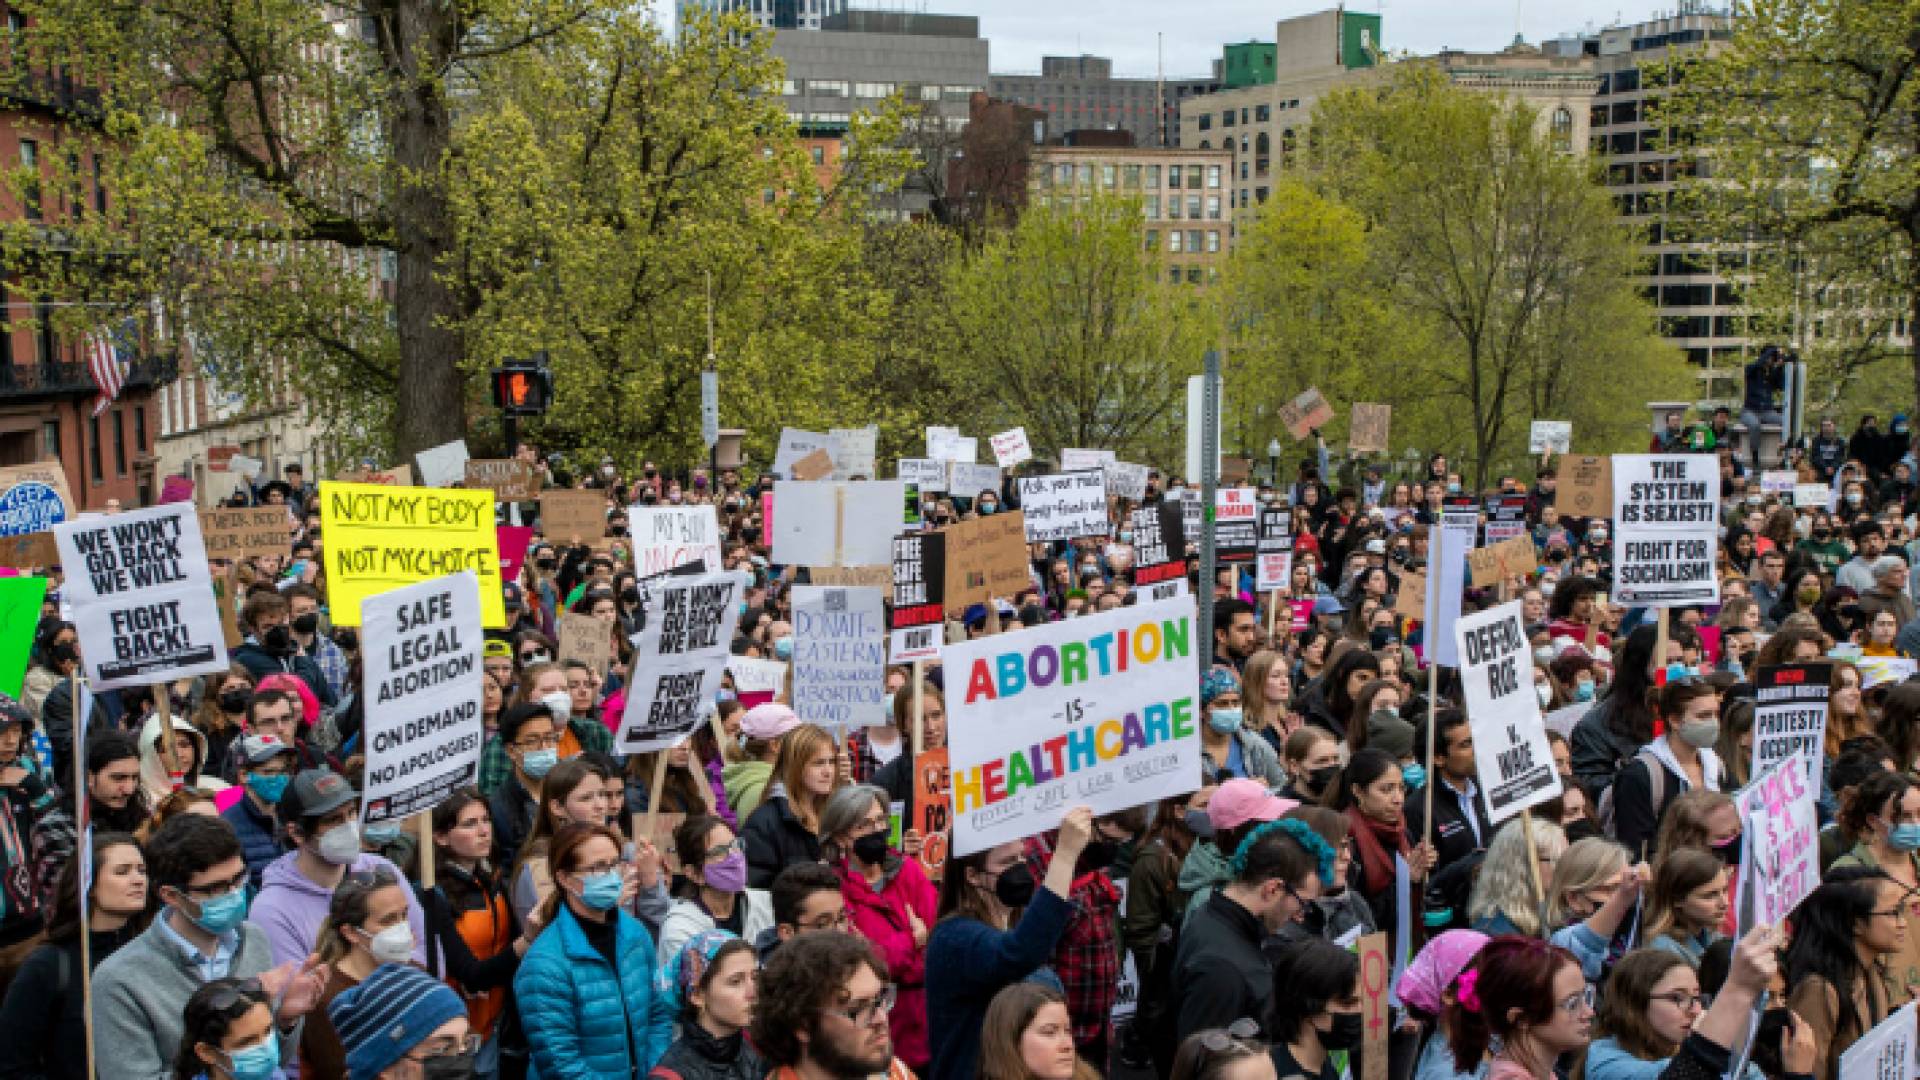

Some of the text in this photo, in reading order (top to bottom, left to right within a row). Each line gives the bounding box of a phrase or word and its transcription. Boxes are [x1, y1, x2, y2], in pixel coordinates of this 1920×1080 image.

[1652, 462, 1687, 479] THE
[1631, 483, 1706, 500] SYSTEM
[331, 494, 486, 526] NOT MY BODY
[1623, 504, 1712, 522] IS SEXIST!
[73, 528, 111, 554] WE
[110, 515, 182, 543] WON'T
[1134, 527, 1162, 547] SAFE
[86, 537, 182, 573] GO BACK
[337, 547, 494, 576] NOT MY CHOICE
[1625, 540, 1708, 561] FIGHT FOR
[91, 558, 187, 595] WE WILL
[894, 561, 921, 583] SAFE
[1620, 562, 1710, 584] SOCIALISM!
[396, 592, 452, 633] SAFE
[662, 588, 687, 611] WE
[111, 600, 181, 635] FIGHT
[662, 612, 687, 633] GO
[114, 624, 190, 659] BACK!
[388, 626, 462, 672] LEGAL
[659, 634, 687, 655] WE
[793, 642, 881, 664] EASTERN
[1464, 615, 1523, 665] DEFEND
[964, 616, 1189, 705] ABORTION
[377, 653, 473, 704] ABORTION
[656, 670, 705, 699] FIGHT
[1488, 656, 1518, 699] ROE
[796, 686, 881, 704] ABORTION
[797, 705, 851, 721] FUND
[1066, 698, 1084, 724] IS
[1758, 710, 1823, 735] PROTEST!
[373, 700, 477, 753] ON DEMAND
[369, 731, 479, 787] NO APOLOGIES!
[954, 697, 1195, 815] HEALTHCARE
[1496, 742, 1535, 780] WADE
[1760, 735, 1818, 759] OCCUPY!
[1034, 783, 1069, 811] SAFE
